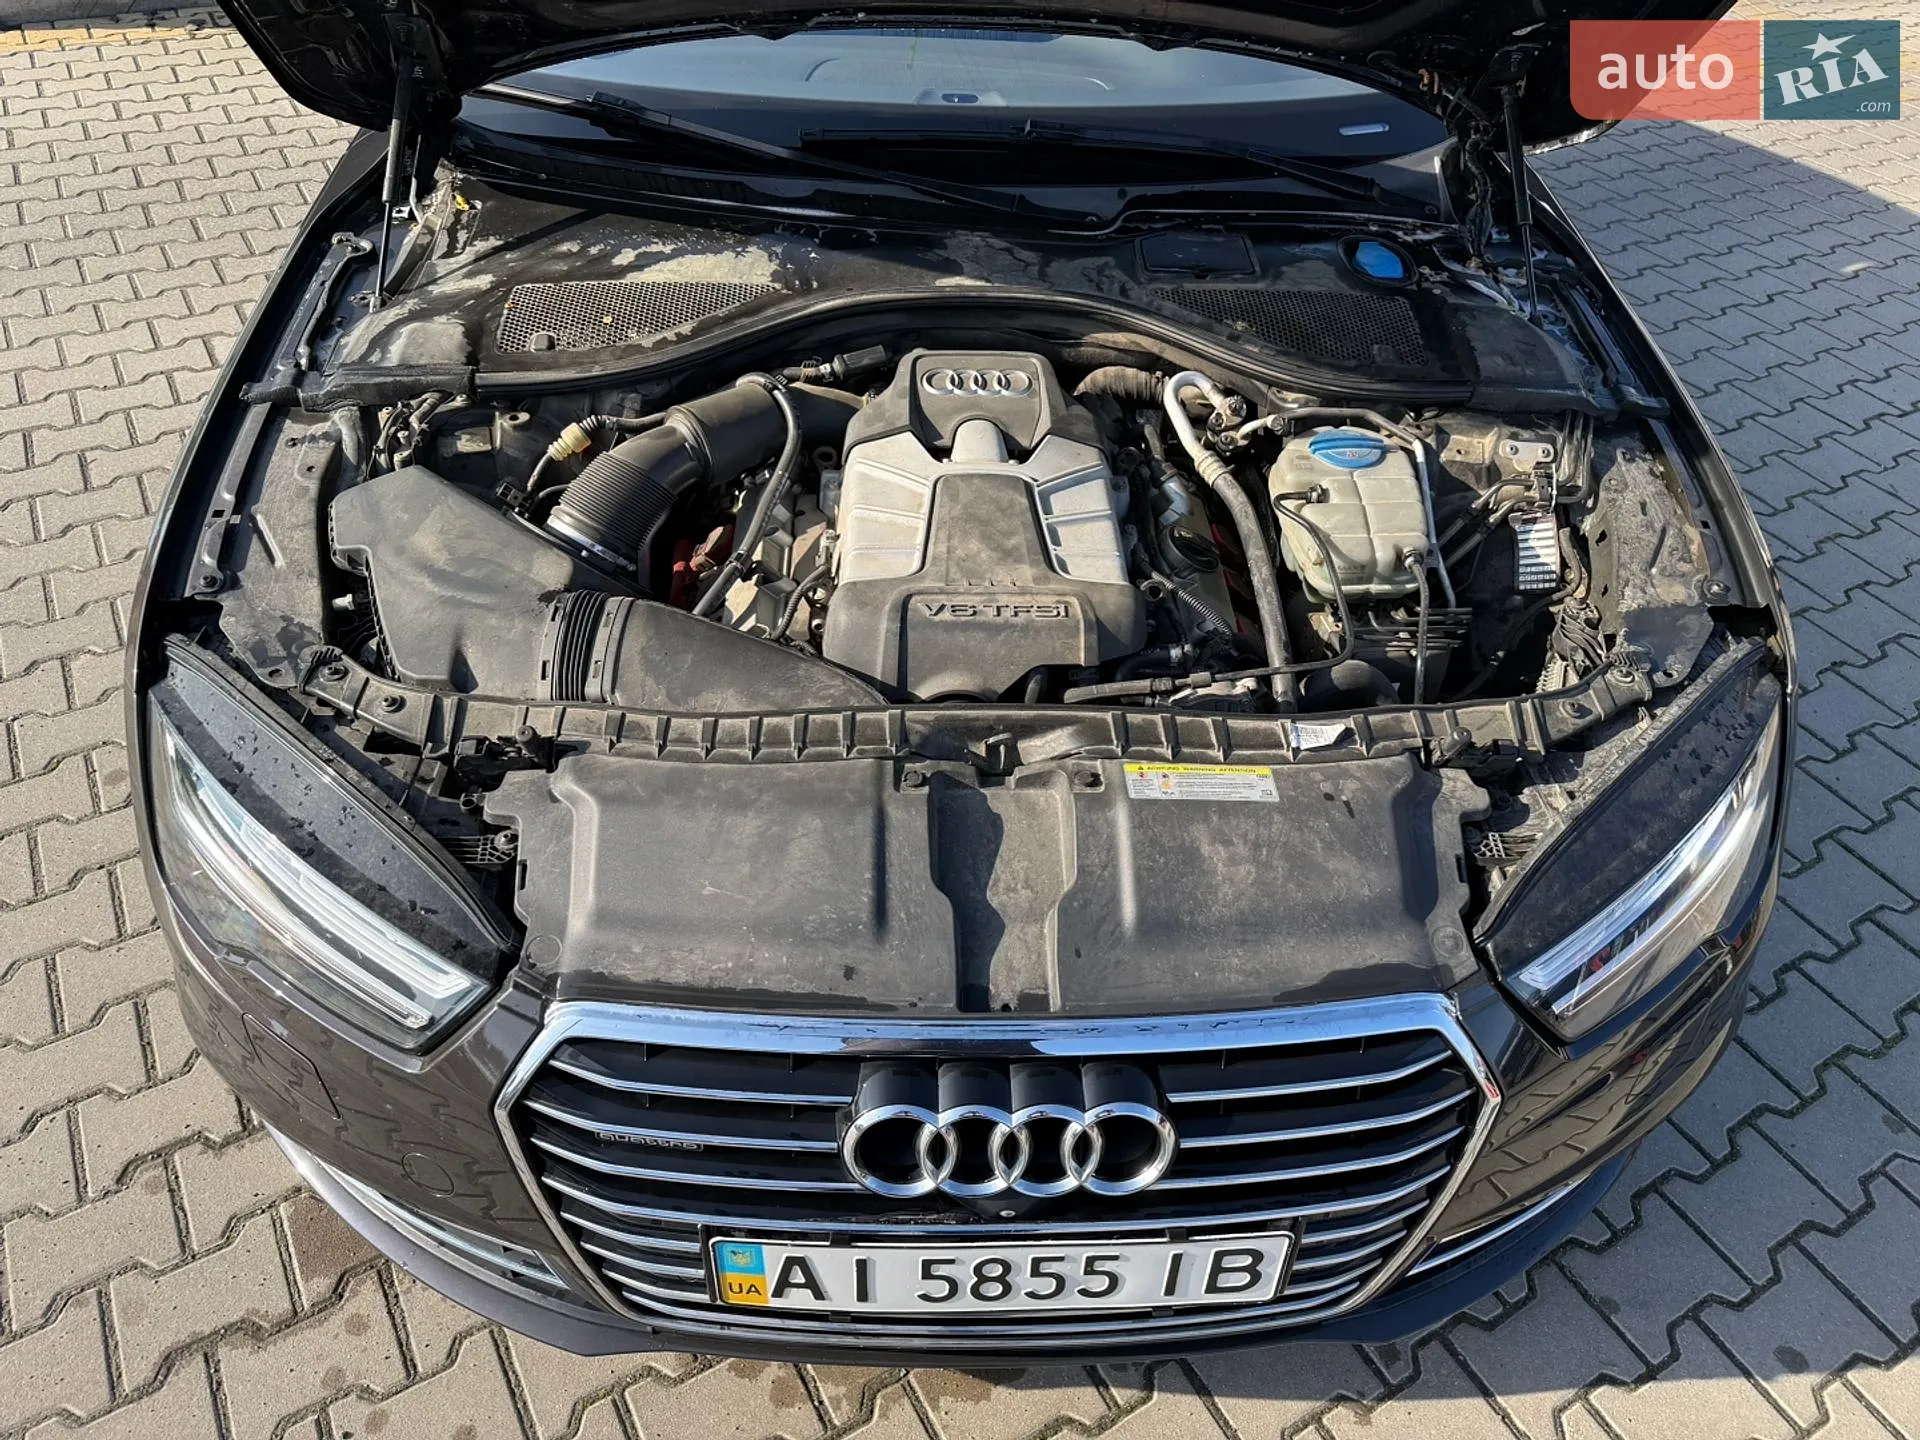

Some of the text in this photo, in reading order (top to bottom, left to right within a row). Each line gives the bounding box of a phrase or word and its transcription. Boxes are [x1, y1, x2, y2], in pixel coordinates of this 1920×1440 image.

[920, 603, 1070, 620] V6 TFSI
[916, 1253, 1121, 1303] 5855
[1160, 1246, 1264, 1298] IB
[727, 1281, 762, 1296] UA
